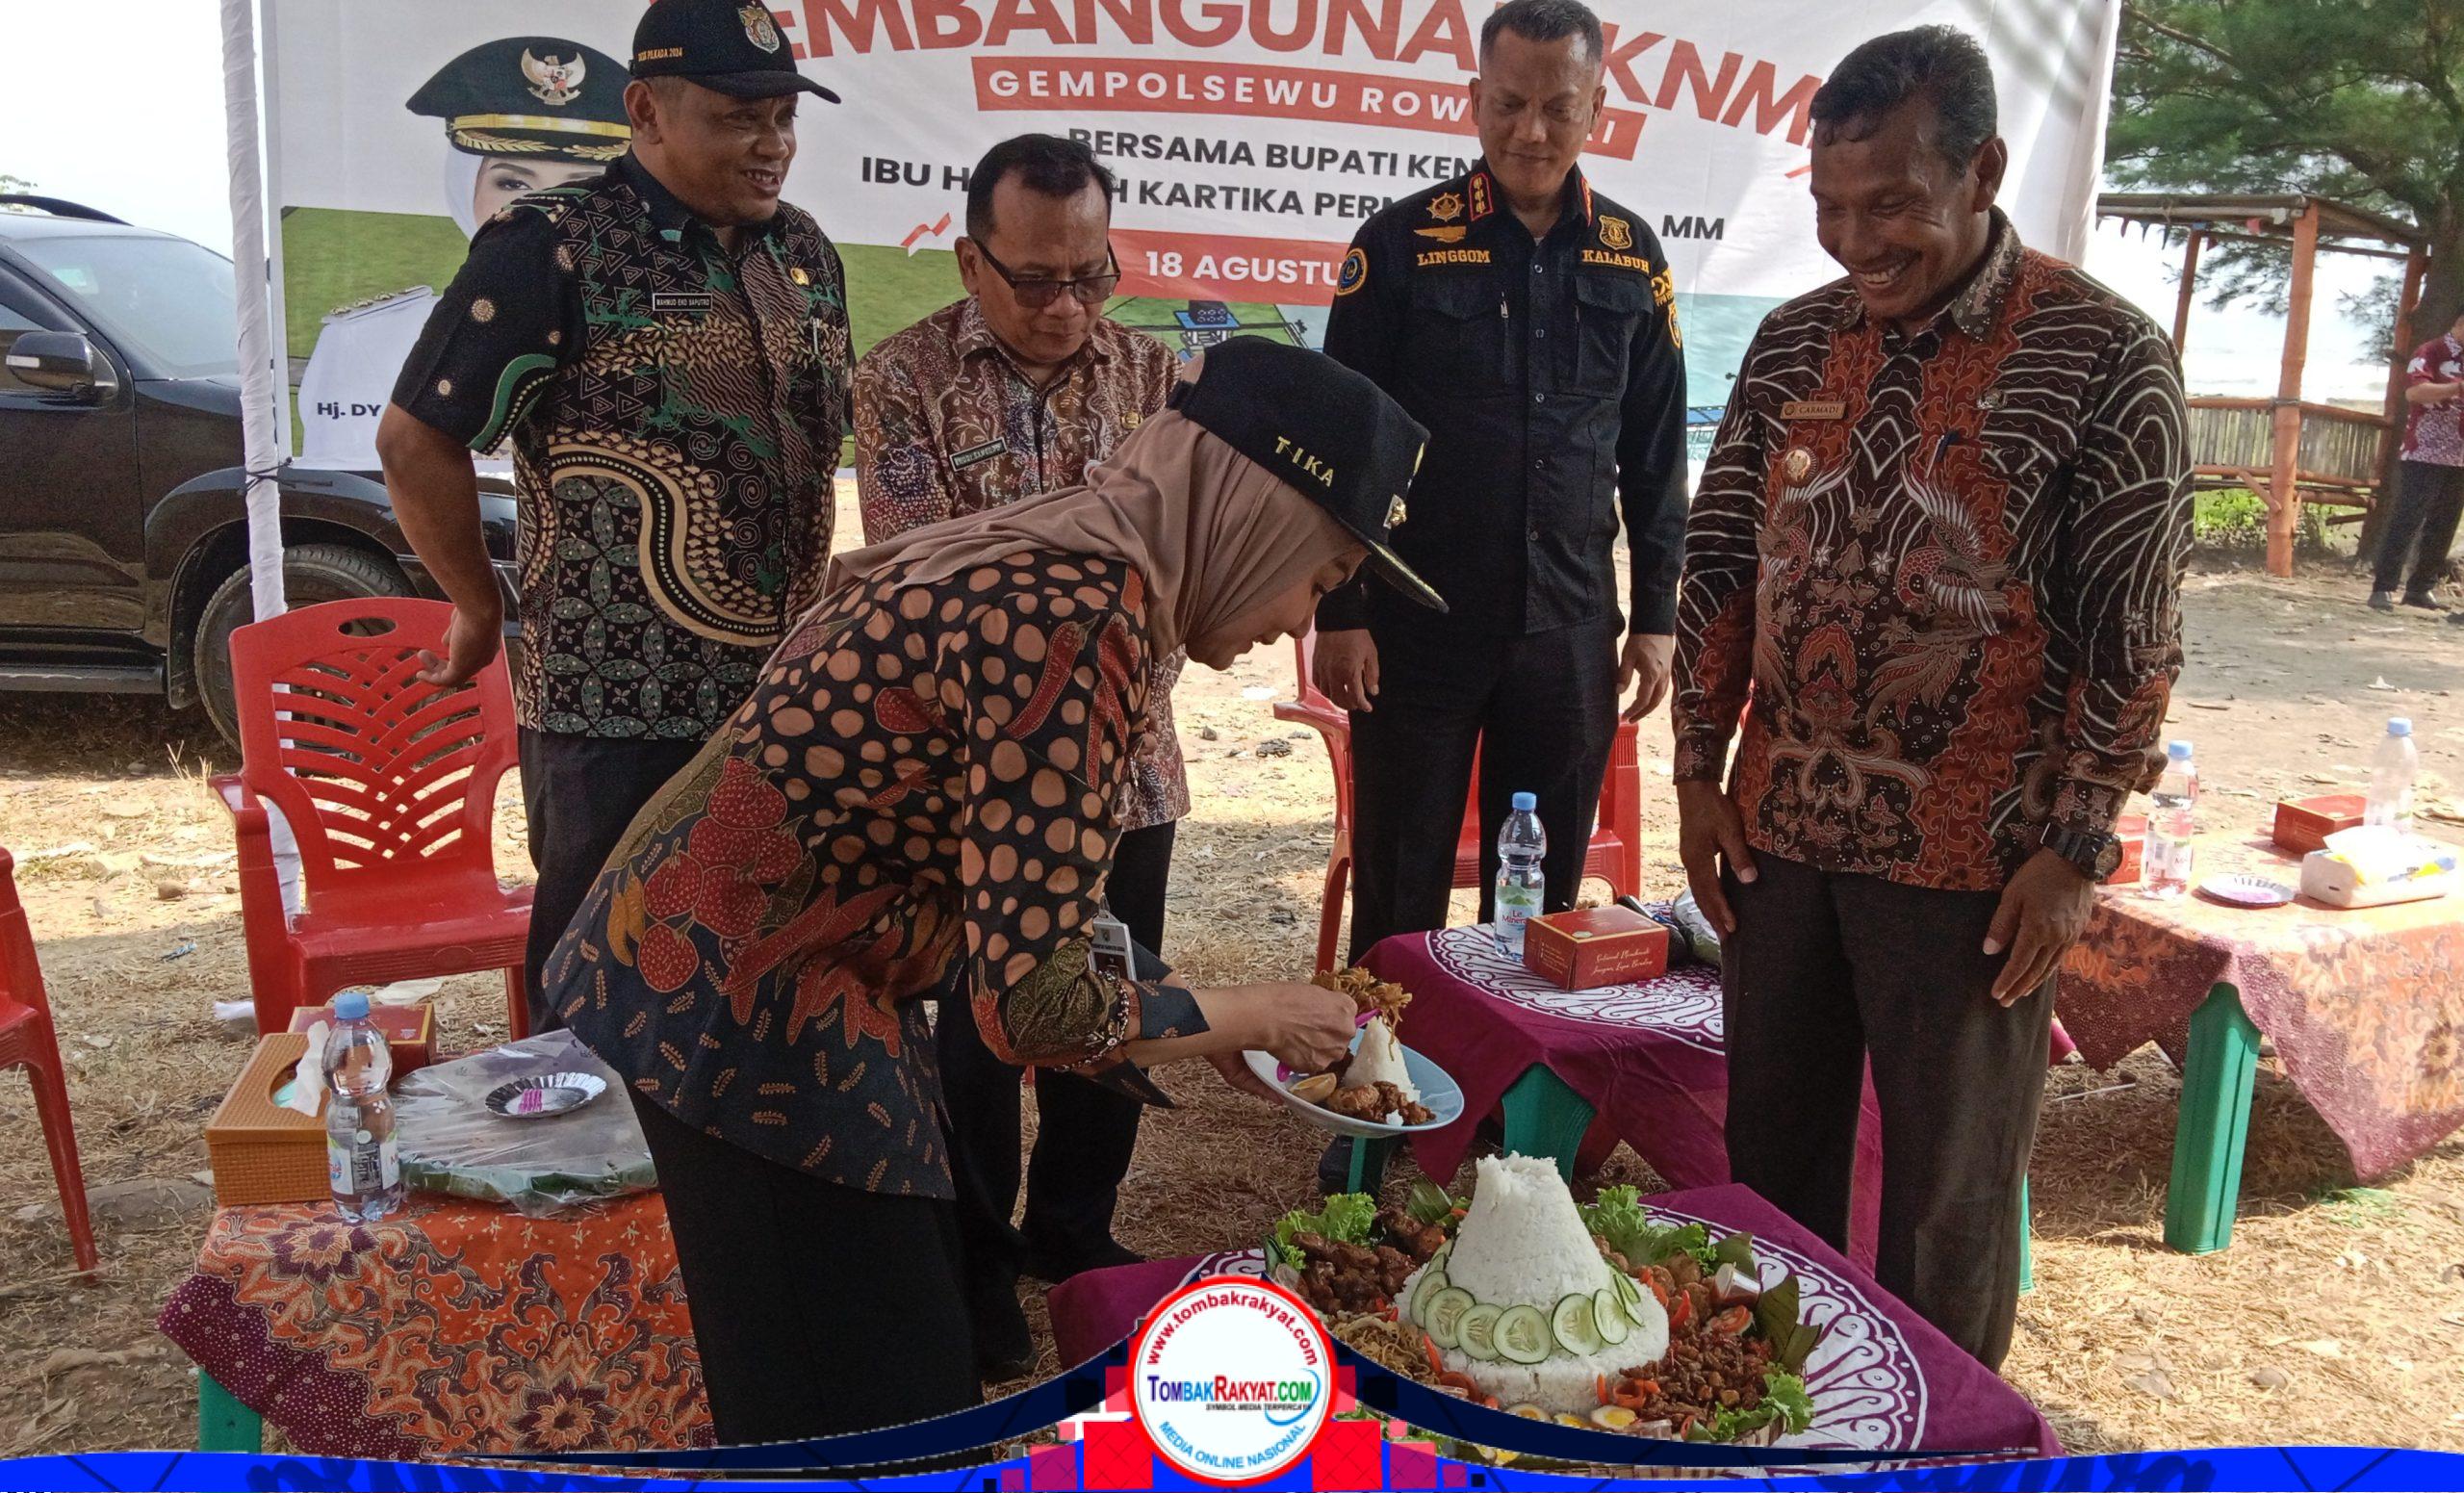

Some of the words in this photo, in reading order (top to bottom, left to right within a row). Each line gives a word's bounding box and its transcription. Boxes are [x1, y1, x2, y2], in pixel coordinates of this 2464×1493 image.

[988, 69, 1337, 109] GEMPOLSEWU
[1600, 22, 1823, 149] KNM
[1069, 128, 1255, 167] BERSAMA
[1266, 144, 1399, 176] BUPATI
[861, 156, 931, 187] IBU
[1139, 180, 1304, 216] KARTIKA
[1661, 214, 1726, 242] MM
[1145, 250, 1183, 278] 18
[1417, 249, 1491, 267] LINGGOM
[317, 401, 346, 420] Hj.
[1274, 435, 1335, 488] TIKA
